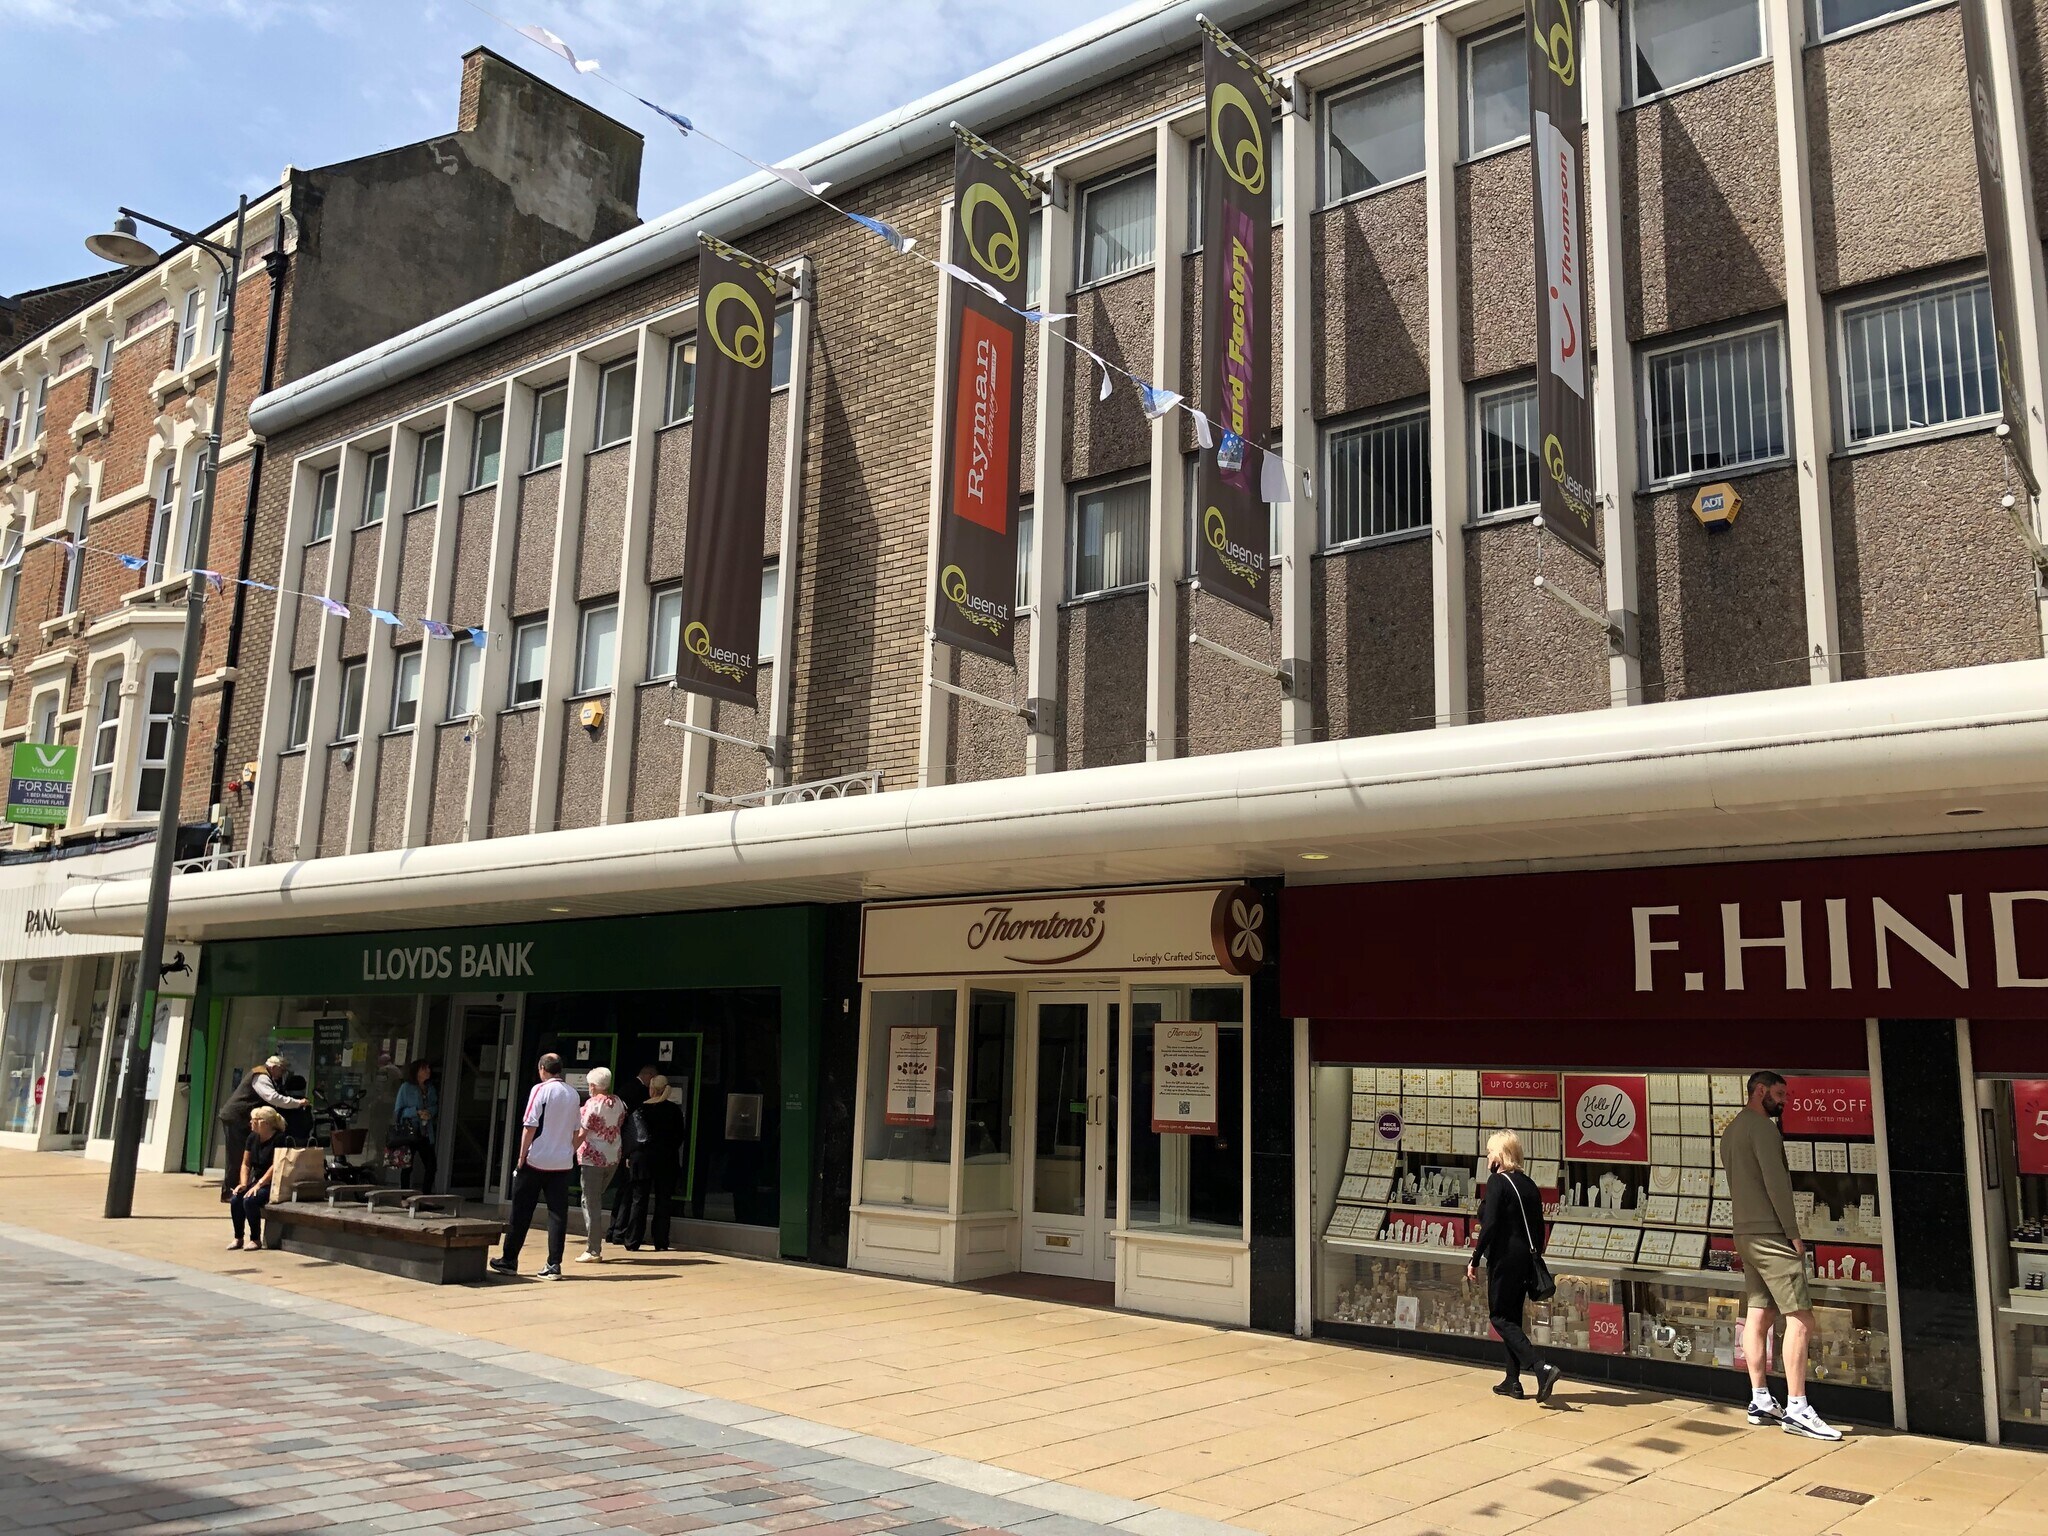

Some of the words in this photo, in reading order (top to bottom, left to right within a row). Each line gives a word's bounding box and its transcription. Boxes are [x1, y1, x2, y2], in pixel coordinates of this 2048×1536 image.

[1560, 151, 1572, 287] Thomson
[1229, 236, 1249, 366] Factory
[1229, 374, 1244, 436] ard
[967, 339, 990, 505] Ryman
[1702, 496, 1723, 510] ADT
[32, 766, 65, 775] Venture
[18, 780, 42, 792] FOR
[44, 782, 73, 793] SALE
[967, 906, 1097, 950] Thorntons
[1632, 890, 2048, 991] F.HIND
[363, 946, 453, 981] LLOYDS
[460, 942, 534, 978] BANK
[1133, 953, 1162, 965] Lovingly
[1164, 952, 1192, 961] Crafted
[1195, 952, 1215, 960] Since
[1515, 1081, 1531, 1089] 50%
[1582, 1093, 1630, 1128] sale
[1584, 1096, 1610, 1112] Hello
[1792, 1098, 1827, 1111] 50%
[1833, 1099, 1867, 1112] OFF
[1593, 1321, 1618, 1335] 50%
